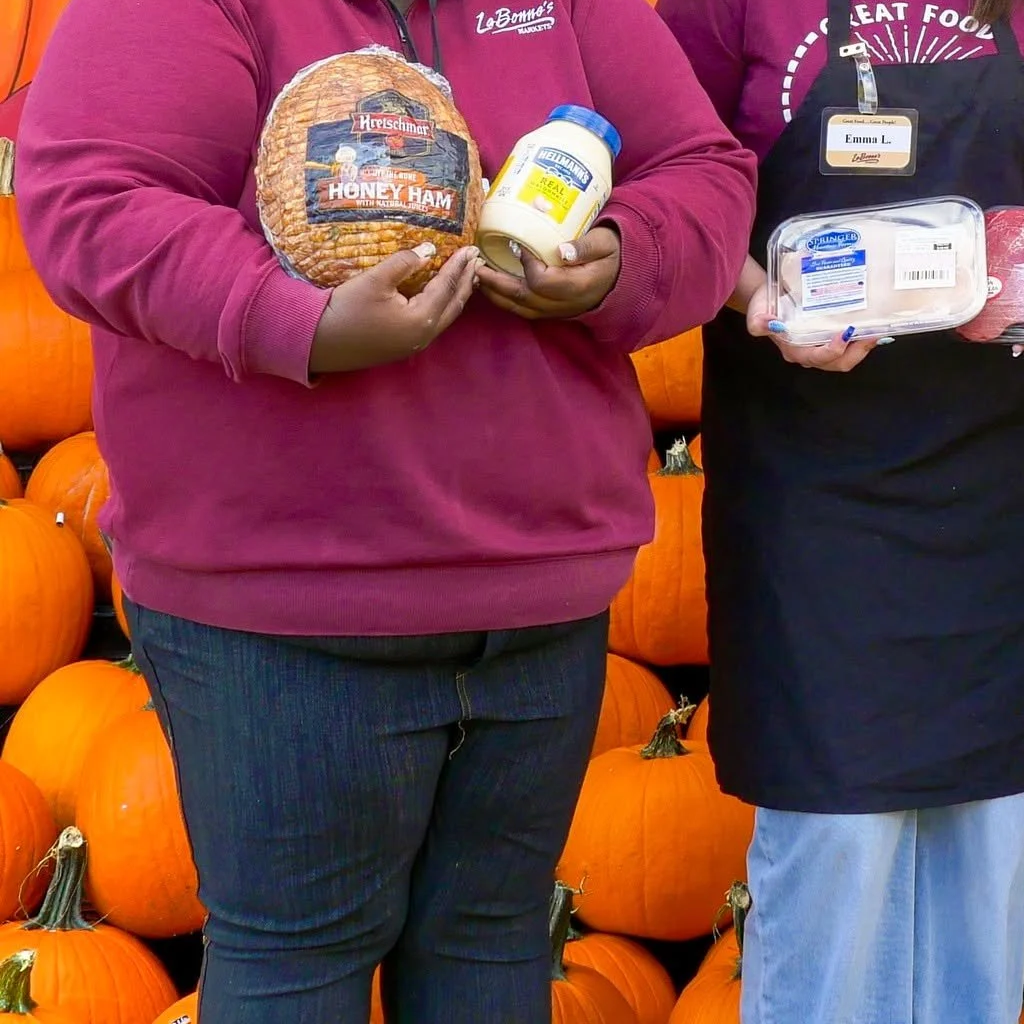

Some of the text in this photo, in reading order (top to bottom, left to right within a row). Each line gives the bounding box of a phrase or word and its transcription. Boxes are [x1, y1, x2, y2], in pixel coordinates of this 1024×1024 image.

[359, 114, 430, 136] Kretschmar
[845, 134, 892, 144] Emma L.
[537, 149, 590, 185] HELLMANN'S
[328, 181, 453, 210] HONEY HAM
[540, 177, 565, 196] REAL
[355, 199, 375, 207] WITH
